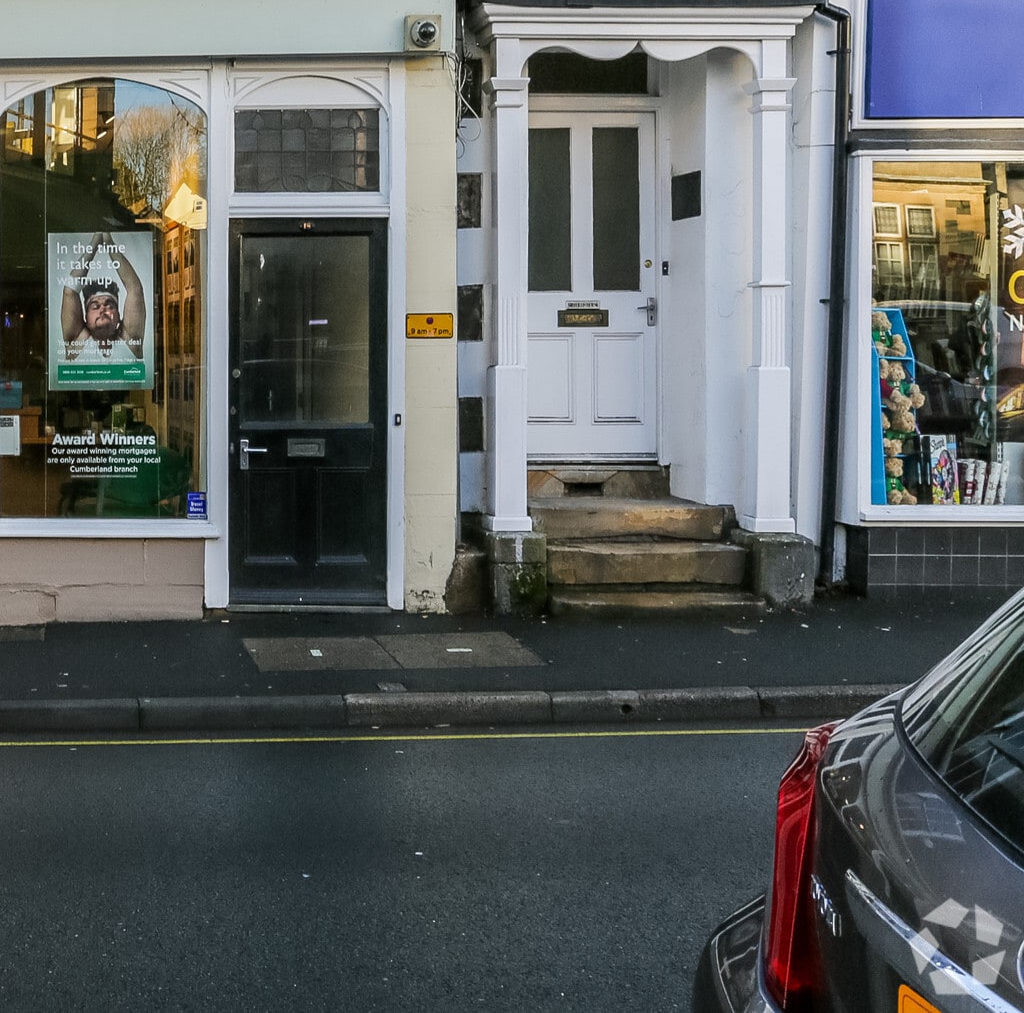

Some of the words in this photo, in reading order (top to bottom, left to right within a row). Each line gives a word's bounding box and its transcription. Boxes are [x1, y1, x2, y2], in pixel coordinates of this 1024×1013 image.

[56, 242, 68, 254] In
[73, 242, 93, 254] the
[97, 242, 126, 254] time
[56, 258, 66, 270] it
[70, 257, 102, 270] takes
[106, 259, 121, 270] to
[56, 276, 93, 286] warm
[97, 277, 113, 289] up
[410, 327, 416, 335] 9
[433, 327, 438, 335] 7
[52, 433, 96, 445] Award
[100, 433, 156, 445] Winners
[51, 447, 65, 455] Our
[66, 447, 88, 455] award
[89, 447, 117, 456] winning
[118, 448, 156, 456] mortgages
[59, 457, 75, 465] only
[76, 456, 108, 464] available
[108, 456, 125, 464] from
[126, 457, 143, 465] your
[144, 456, 161, 464] local
[69, 465, 113, 473] Cumberland
[113, 465, 138, 473] branch
